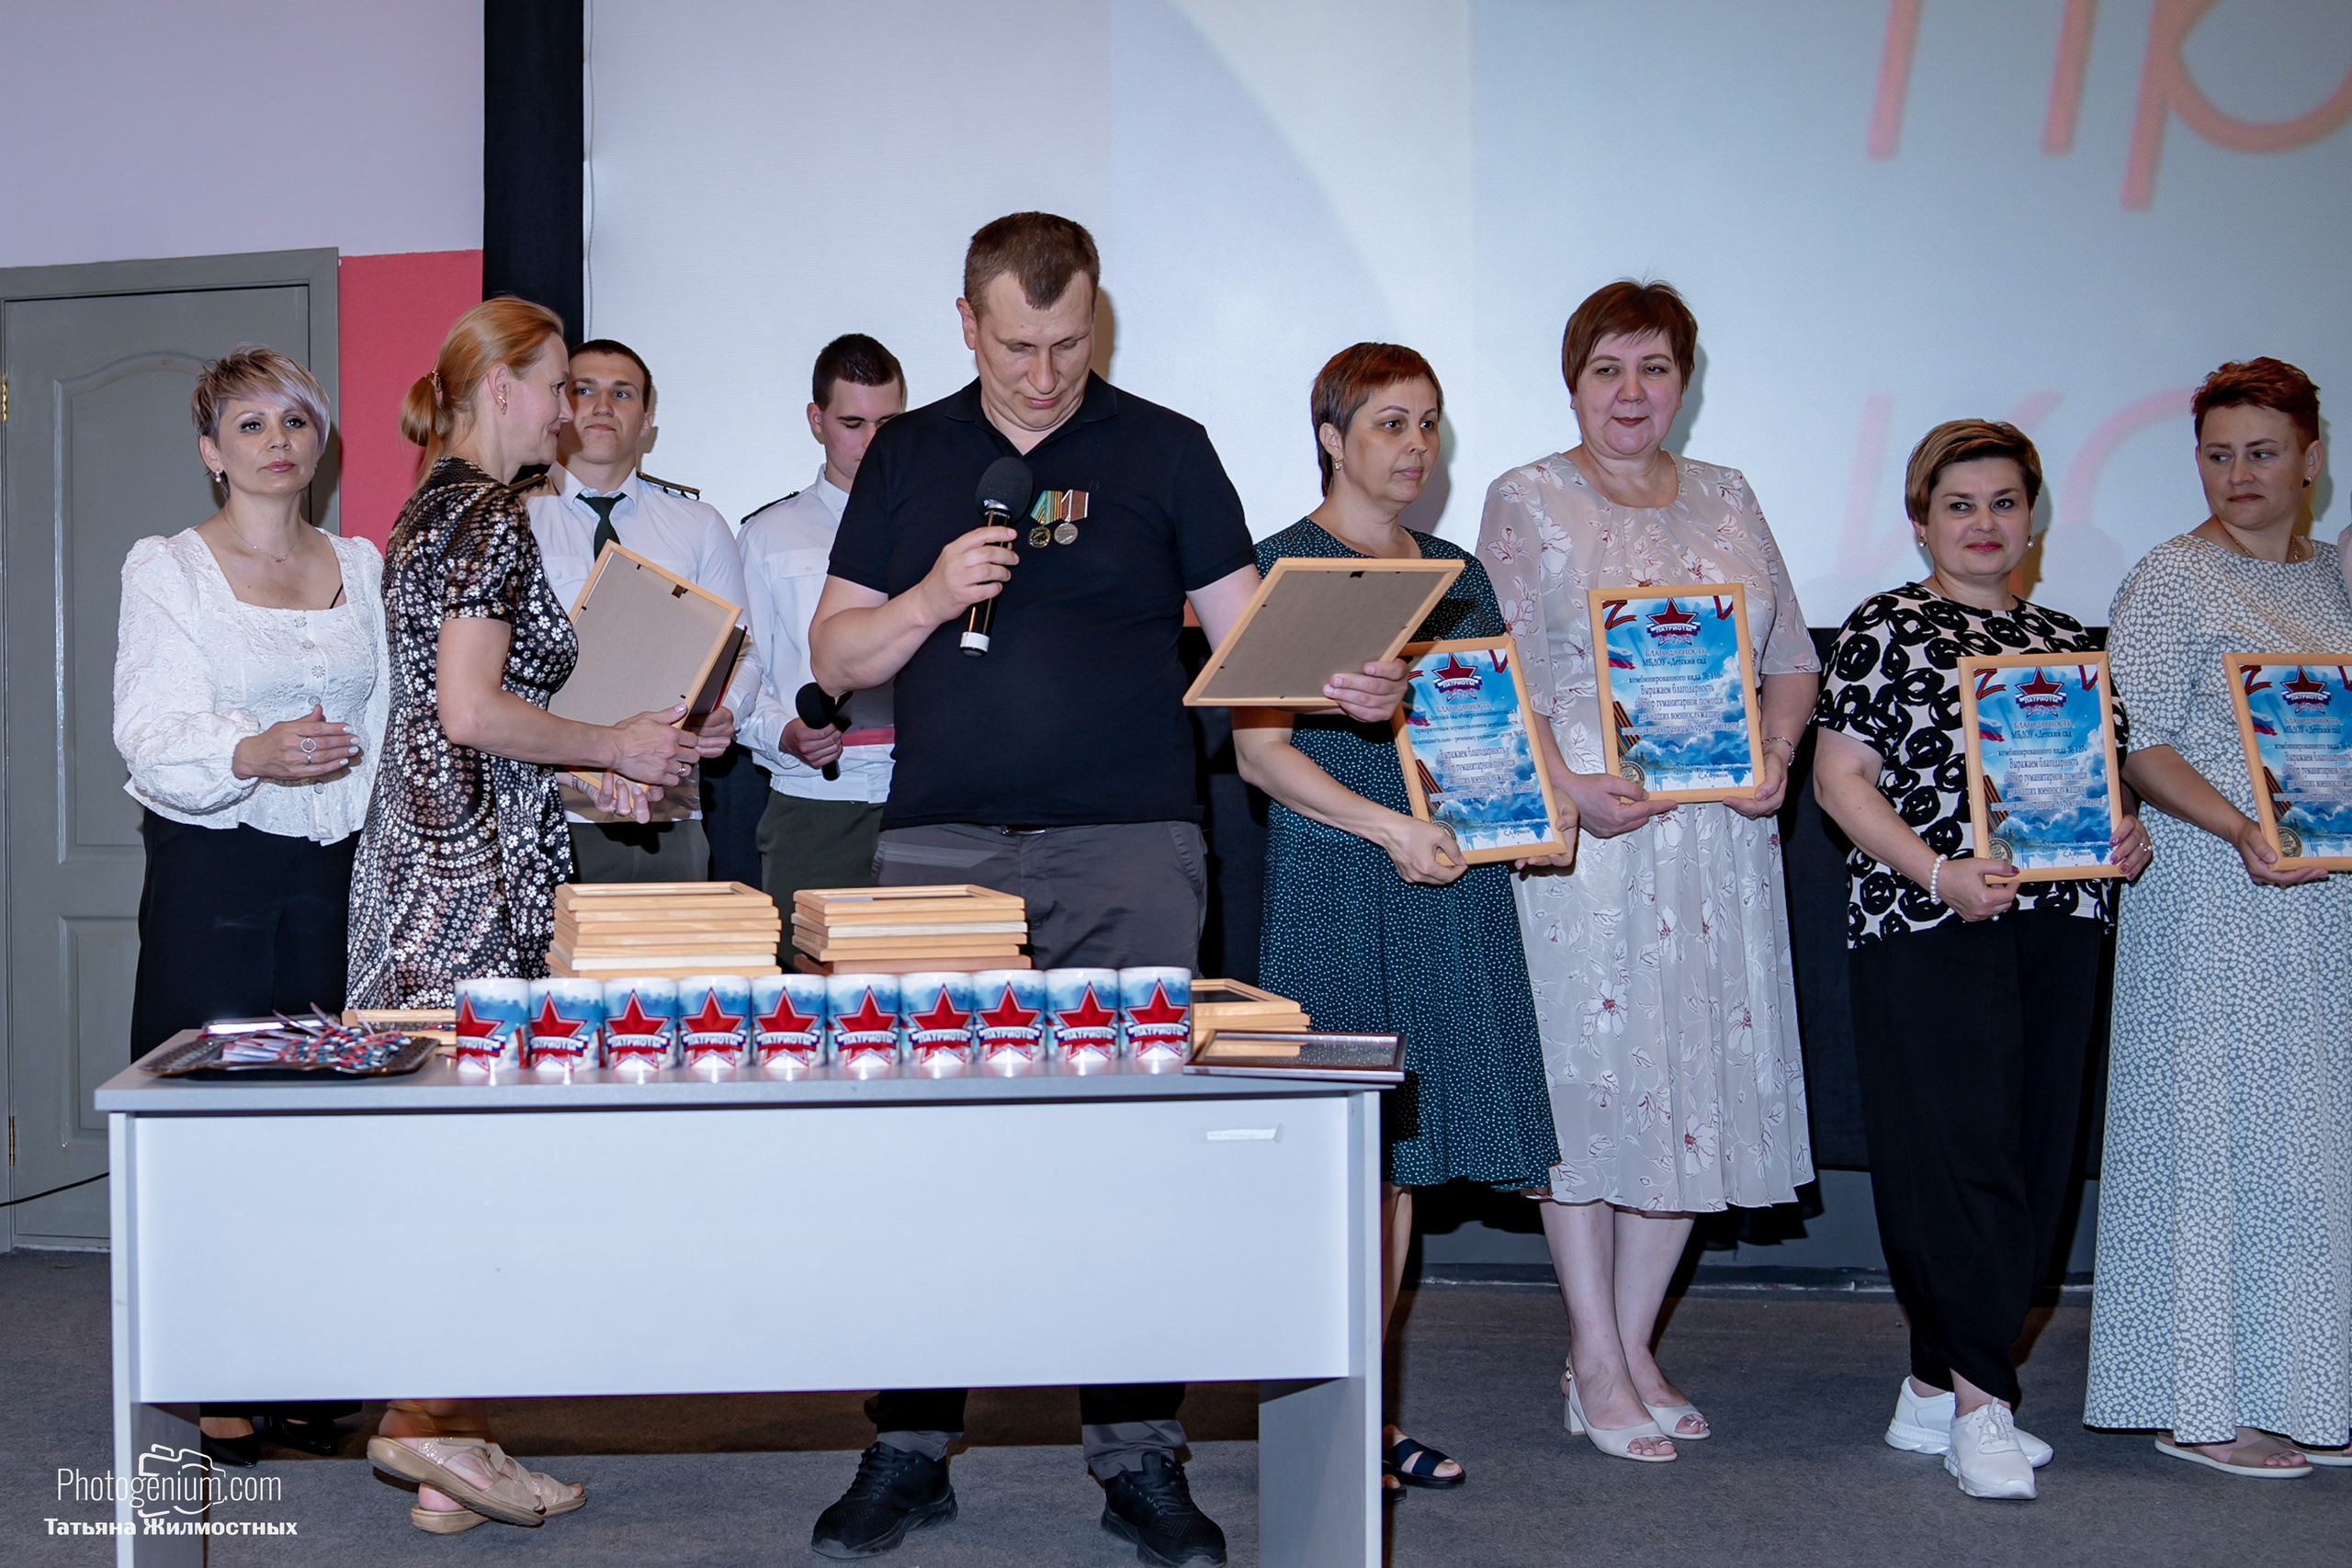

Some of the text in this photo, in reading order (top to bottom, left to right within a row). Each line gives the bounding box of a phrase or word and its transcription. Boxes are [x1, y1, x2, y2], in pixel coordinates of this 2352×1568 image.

[1656, 625, 1692, 633] ПАТРИОТЫ
[1645, 648, 1706, 657] БЛАГОДАРНОСТЬ
[1643, 659, 1666, 667] МБДОУ
[1442, 679, 1476, 688] ПАТРИОТЫ
[1629, 675, 1686, 684] комбинированного
[1640, 683, 1714, 697] Выражаем благодарность
[1657, 697, 1697, 710] гуманитарной
[1698, 698, 1724, 706] помощи
[2024, 695, 2059, 704] ПАТРИОТЫ
[1436, 703, 1492, 713] БЛАГОДАРНОСТЬ
[2014, 720, 2073, 728] БЛАГОДАРНОСТЬ
[2011, 731, 2033, 739] МБДОУ
[1997, 748, 2052, 758] комбинированного
[2009, 757, 2079, 772] Выражаем благодарность
[2024, 772, 2063, 785] гуманитарной
[2064, 772, 2087, 781] помощи
